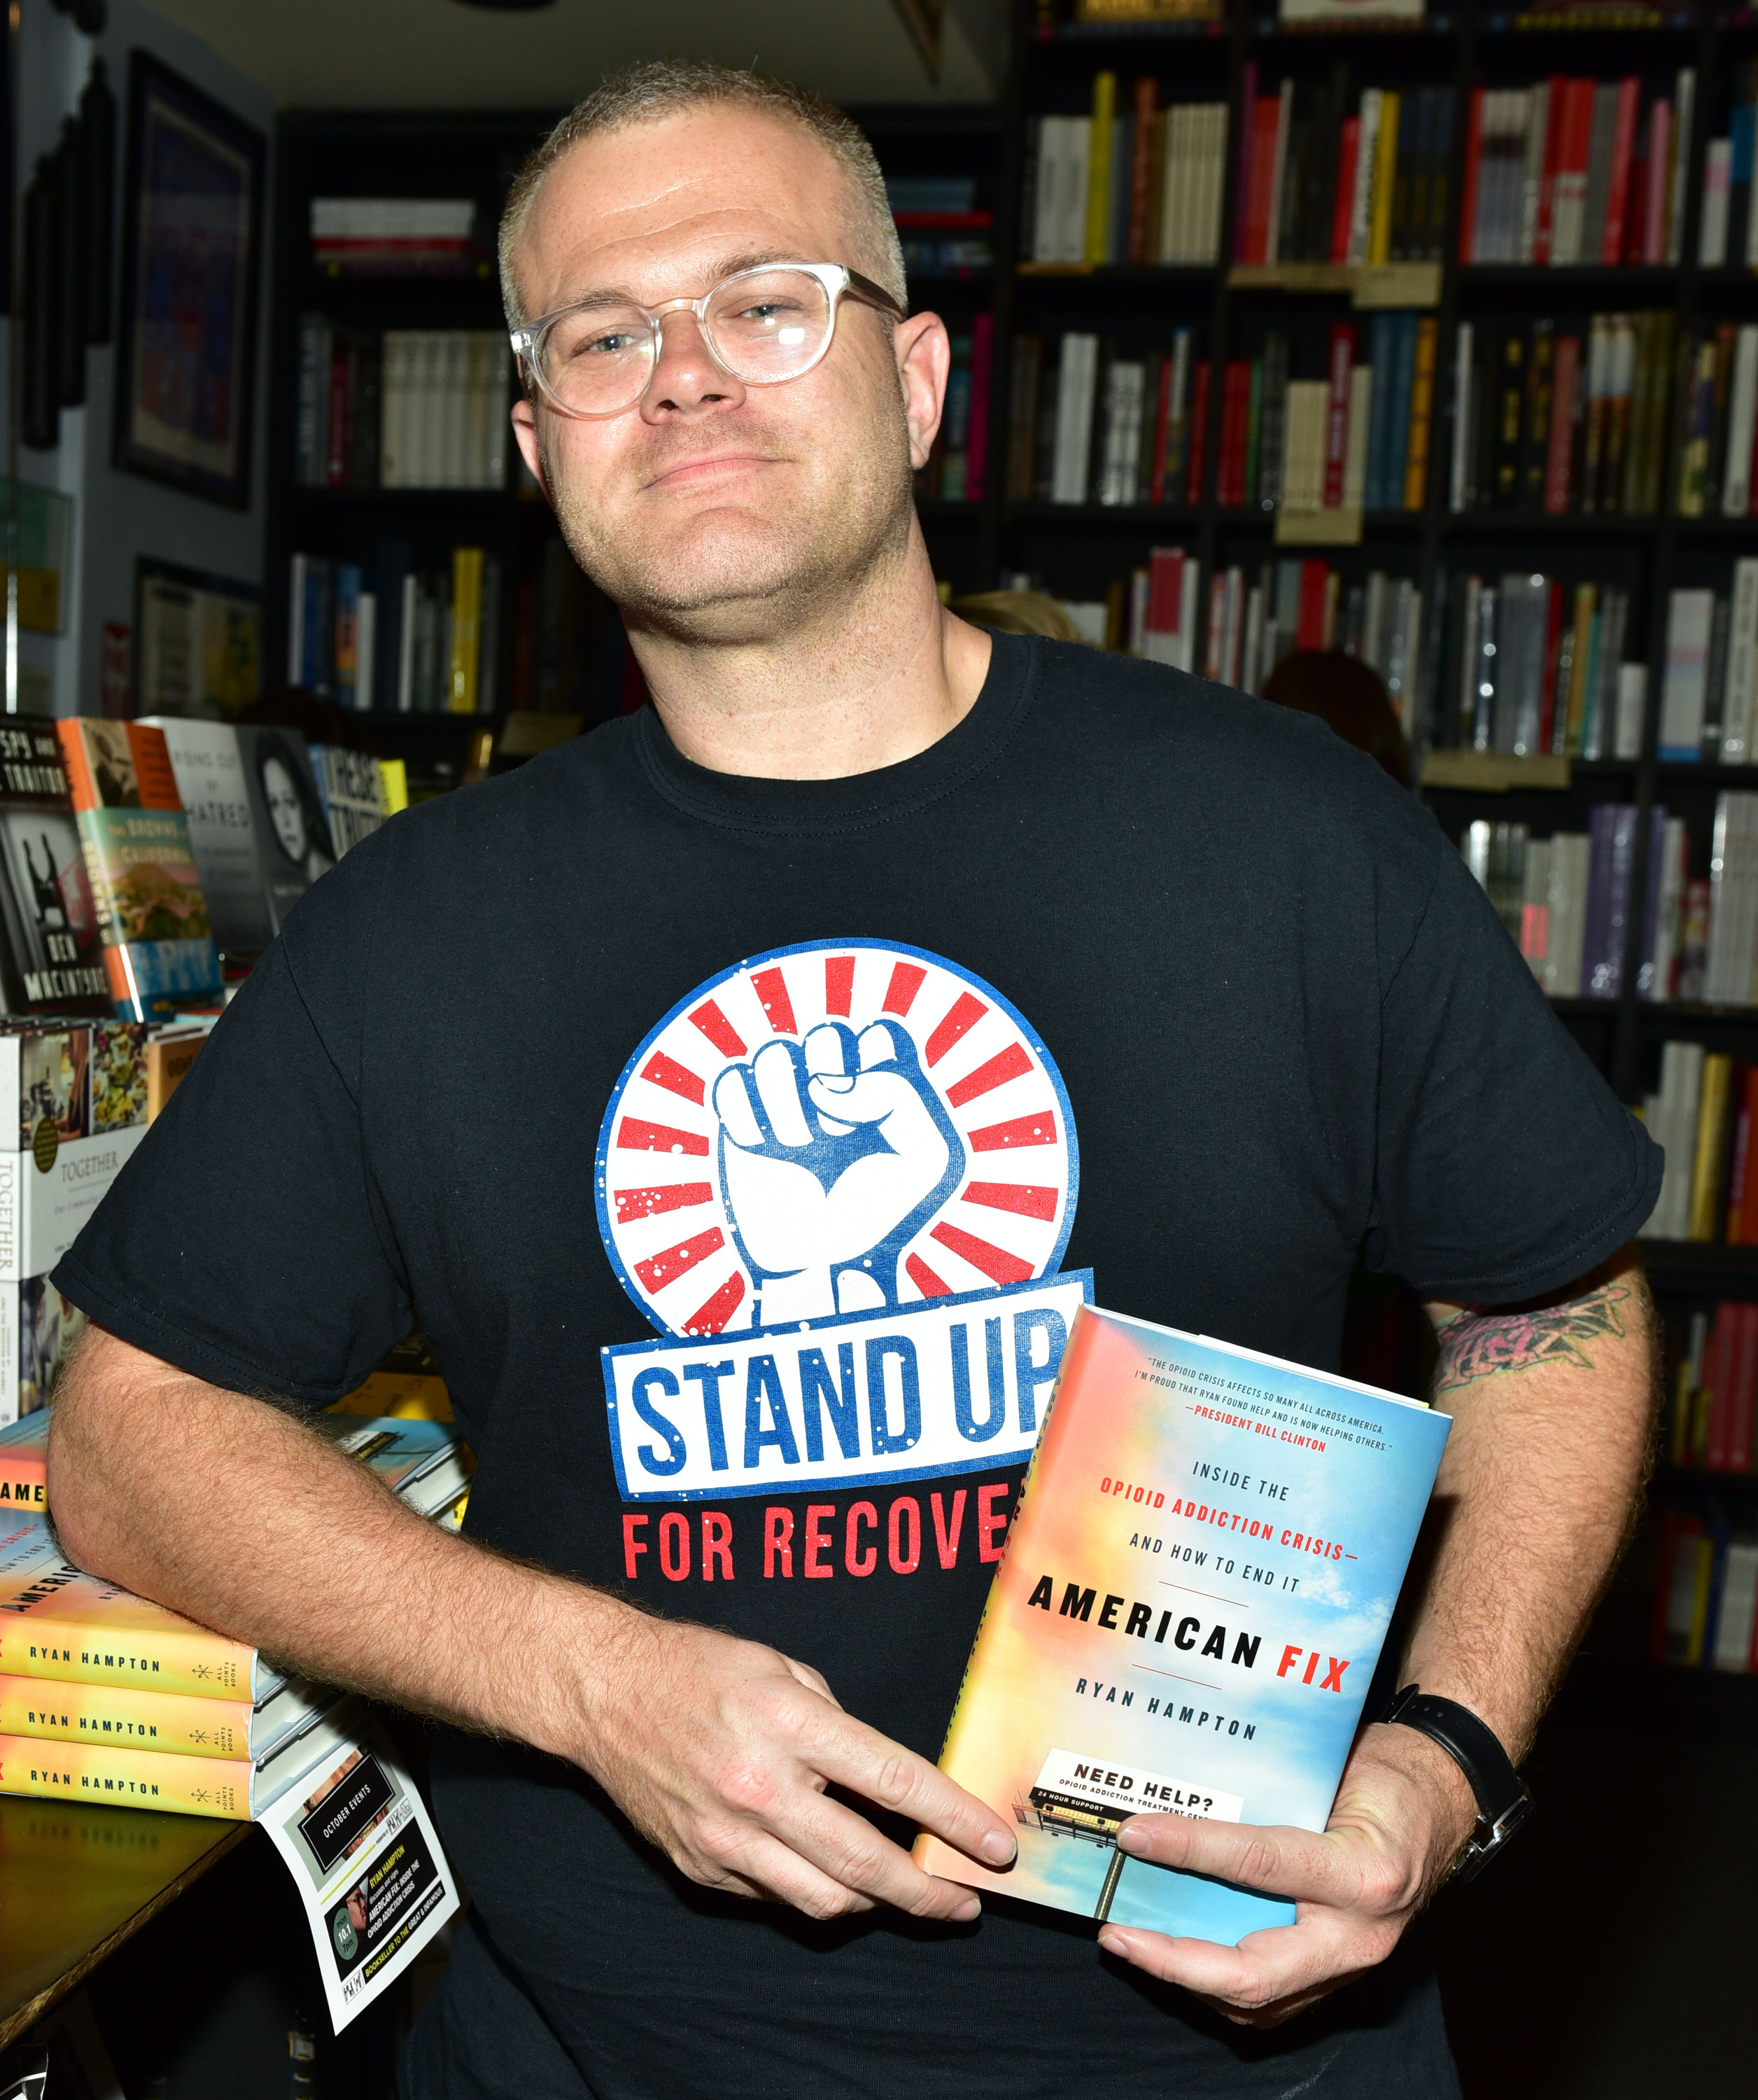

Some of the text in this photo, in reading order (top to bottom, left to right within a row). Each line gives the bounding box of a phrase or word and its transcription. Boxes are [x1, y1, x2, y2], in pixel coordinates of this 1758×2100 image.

[61, 1150, 119, 1183] TOGETHER
[631, 1308, 1068, 1477] STAND UP
[1149, 1374, 1176, 1390] PROUD
[1179, 1382, 1199, 1396] THAT
[1199, 1389, 1221, 1403] RYAN
[1221, 1396, 1249, 1411] FOUND
[1250, 1404, 1271, 1417] HELP
[1272, 1410, 1288, 1422] AND
[1290, 1415, 1299, 1425] IS
[1300, 1419, 1319, 1432] NOW
[1320, 1424, 1353, 1442] HELPING
[1168, 1363, 1197, 1378] OPIOID
[1198, 1372, 1226, 1387] CRISIS
[1226, 1381, 1262, 1399] AFFECTS
[1263, 1392, 1274, 1402] SO
[1275, 1395, 1299, 1409] MANY
[1299, 1403, 1313, 1414] ALL
[1315, 1407, 1346, 1424] ACROSS
[1348, 1417, 1384, 1435] AMERICA.
[1254, 1422, 1277, 1438] BILL
[1280, 1430, 1326, 1452] CLINTON
[1192, 1460, 1290, 1502] INSIDE THE
[1099, 1476, 1165, 1509] OPIOID
[1171, 1498, 1274, 1541] ADDICTION
[25, 1545, 46, 1555] END
[622, 1511, 735, 1583] FOR
[1129, 1532, 1300, 1592] AND HOW TO END IT
[1027, 1574, 1351, 1693] AMERICAN FIX
[30, 1646, 160, 1672] RYAN HAMPTON
[29, 1712, 157, 1737] RYAN HAMPTON
[1075, 1677, 1257, 1741] RYAN HAMPTON
[31, 1770, 159, 1795] RYAN HAMPTON
[1048, 1793, 1069, 1803] HOUR
[1071, 1799, 1104, 1812] SUPPORT
[1059, 1779, 1088, 1791] OPIOID
[1090, 1786, 1134, 1803] ADDICTION
[1137, 1799, 1185, 1816] TREATMENT
[1074, 1763, 1214, 1812] NEED HELP?
[323, 1784, 371, 1838] OCTOBER EVENTS
[369, 1868, 384, 1889] RYAN
[381, 1844, 405, 1875] HAMPTON
[369, 1886, 385, 1905] discusses
[390, 1868, 399, 1881] signs
[367, 1880, 416, 1938] OPIOID ADDICTION CRISIS
[369, 1858, 421, 1923] AMERICAN FIX: INSIDE THE
[336, 1914, 348, 1929] mon
[338, 1923, 351, 1943] 10.1
[365, 1886, 443, 1977] BOOKSELLER TO THE GREAT & INFAMOUS
[342, 1938, 354, 1953] 7pm
